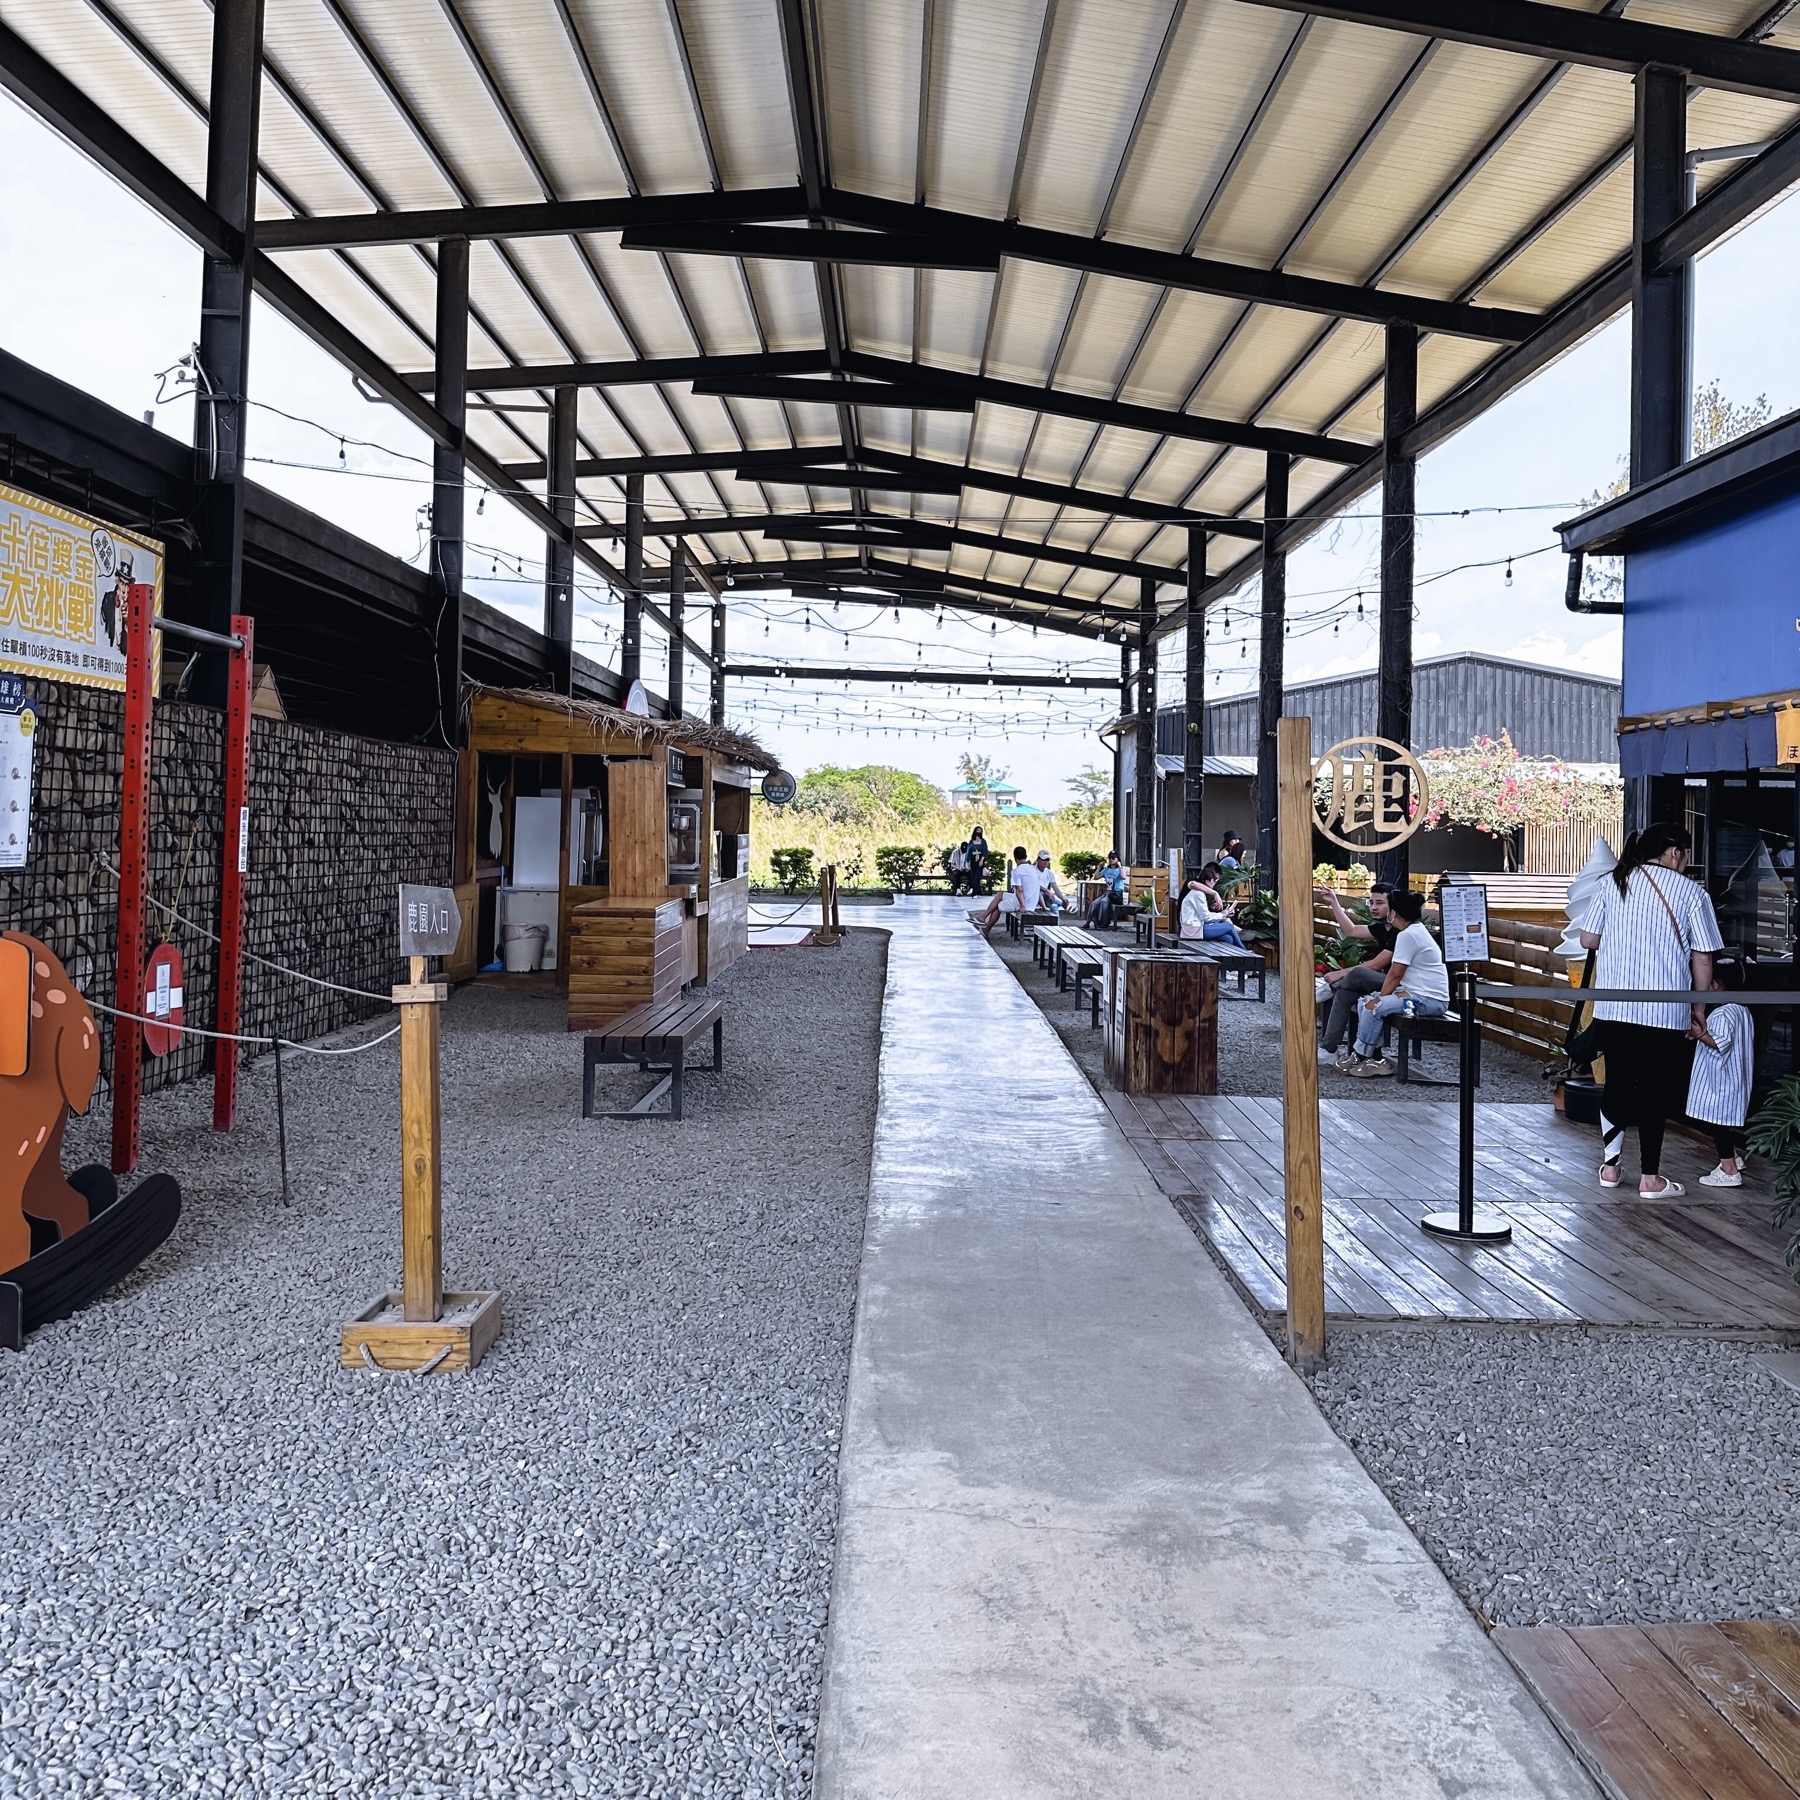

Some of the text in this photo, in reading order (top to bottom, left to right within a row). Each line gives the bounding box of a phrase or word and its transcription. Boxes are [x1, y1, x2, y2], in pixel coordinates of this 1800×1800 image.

[2, 519, 95, 585] 十倍獎金
[0, 565, 94, 638] 大挑戰
[0, 638, 79, 666] 住單槓100秒沒有落地
[1321, 748, 1412, 835] 鹿
